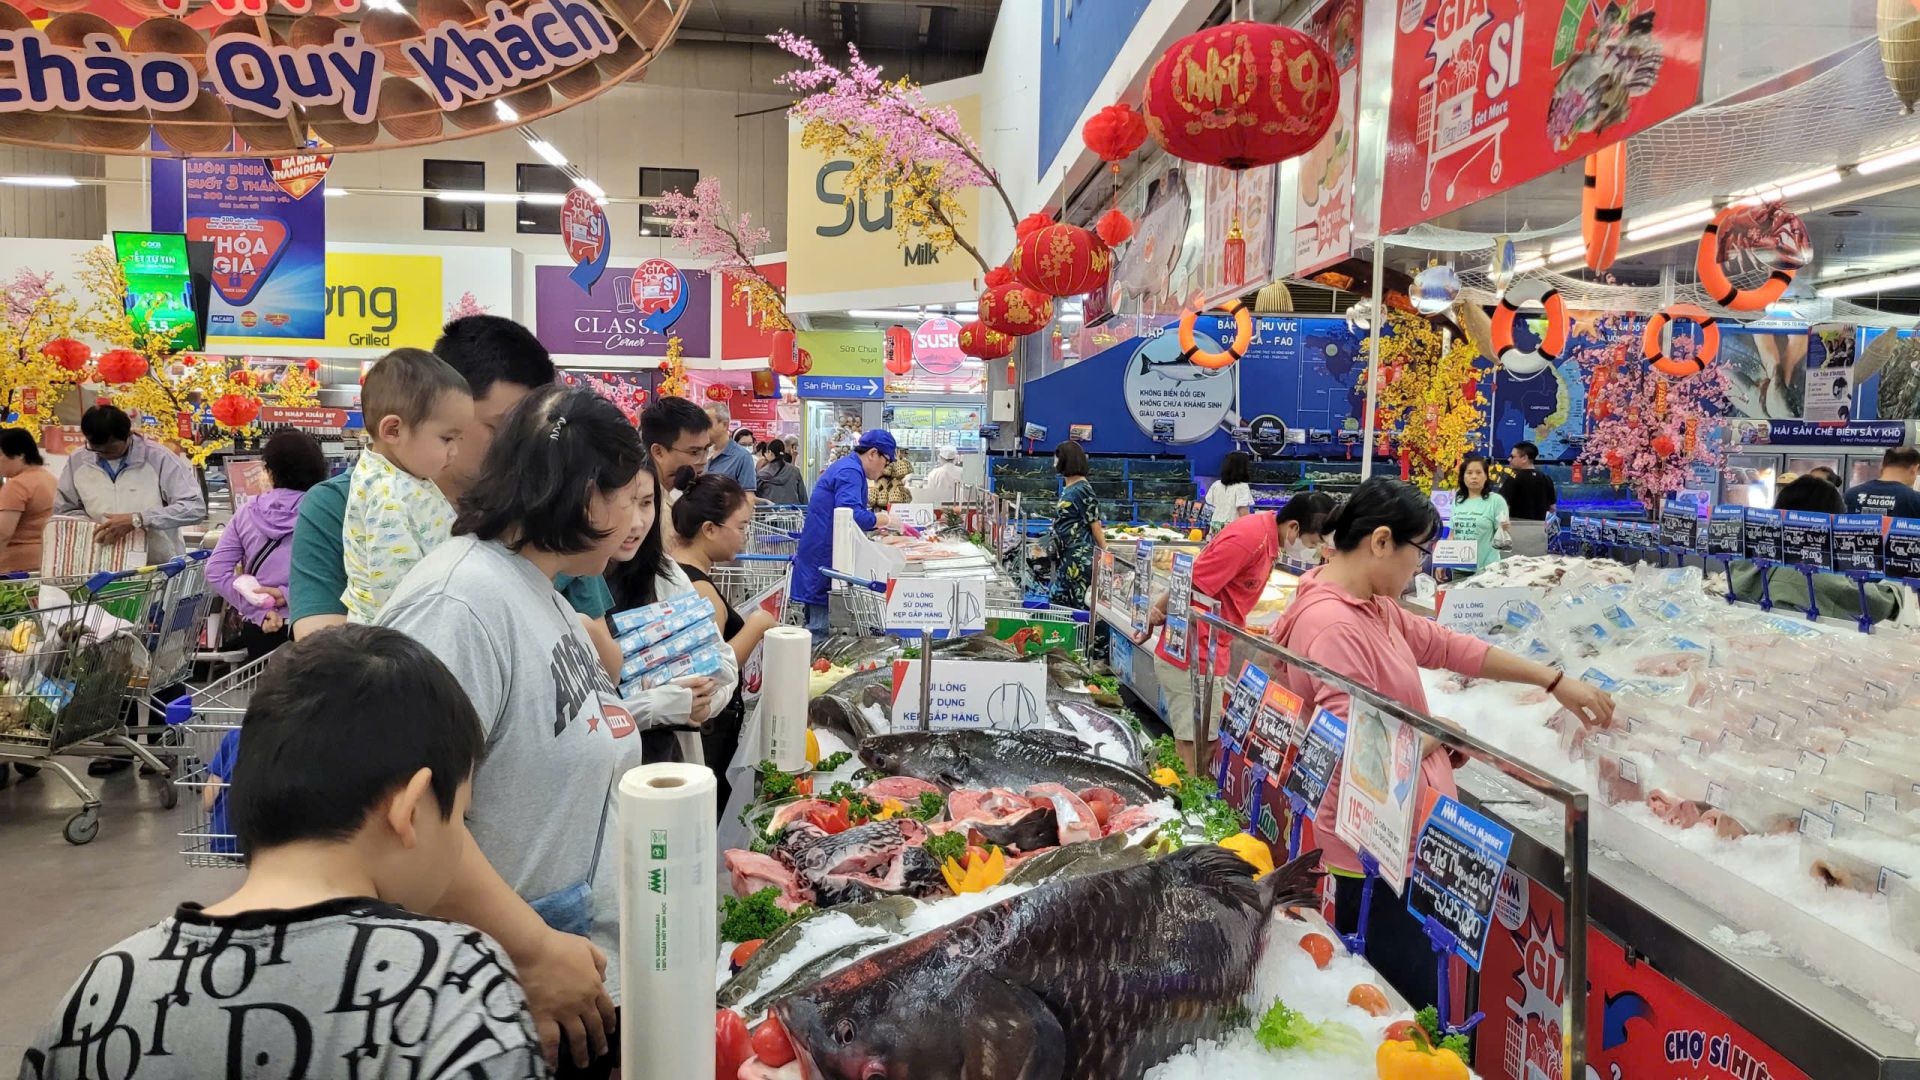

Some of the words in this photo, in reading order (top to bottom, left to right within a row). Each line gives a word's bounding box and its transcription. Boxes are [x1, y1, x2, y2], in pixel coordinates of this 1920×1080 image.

[215, 36, 376, 116] Quý
[408, 0, 610, 103] Khách
[1474, 109, 1487, 127] Get
[1488, 102, 1509, 121] More
[303, 162, 328, 174] DEAL
[226, 177, 238, 190] 3
[904, 242, 940, 267] Milk
[349, 333, 390, 347] Grilled
[605, 334, 646, 350] Corner
[1274, 336, 1293, 346] FAO
[858, 345, 878, 353] Chua
[803, 381, 818, 390] Sản
[821, 381, 843, 391] Phẩm
[845, 382, 861, 391] Sữa
[1773, 424, 1790, 435] HẢI
[1792, 424, 1812, 435] SẢN
[1814, 425, 1834, 436] CHẾ
[916, 591, 934, 599] LÒNG
[924, 610, 943, 618] HÀNG
[939, 681, 967, 692] LÒNG
[937, 698, 966, 710] DỤNG
[951, 711, 980, 722] HÀNG
[1664, 1030, 1706, 1069] CHỢ
